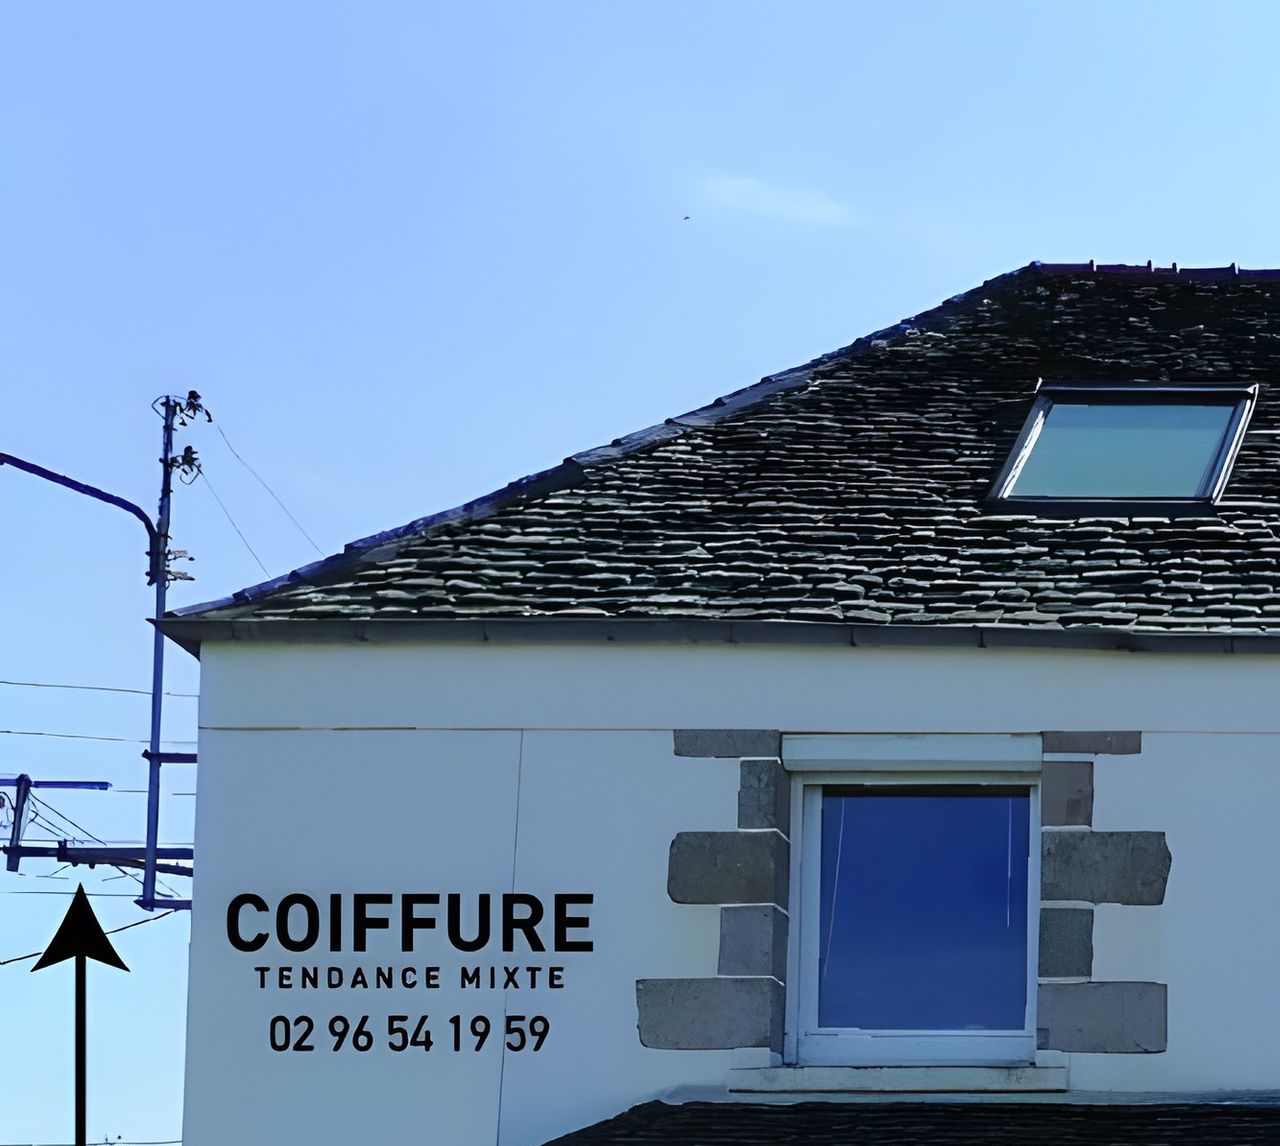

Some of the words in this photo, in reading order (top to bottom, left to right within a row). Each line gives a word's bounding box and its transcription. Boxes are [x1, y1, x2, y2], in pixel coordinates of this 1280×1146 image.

[226, 893, 594, 953] COIFFURE
[254, 966, 440, 990] TENDANCE
[460, 966, 565, 990] MIXTE
[269, 1015, 315, 1052] 02
[328, 1015, 373, 1052] 96
[387, 1015, 433, 1052] 54
[448, 1015, 491, 1052] 19
[505, 1015, 550, 1052] 59
